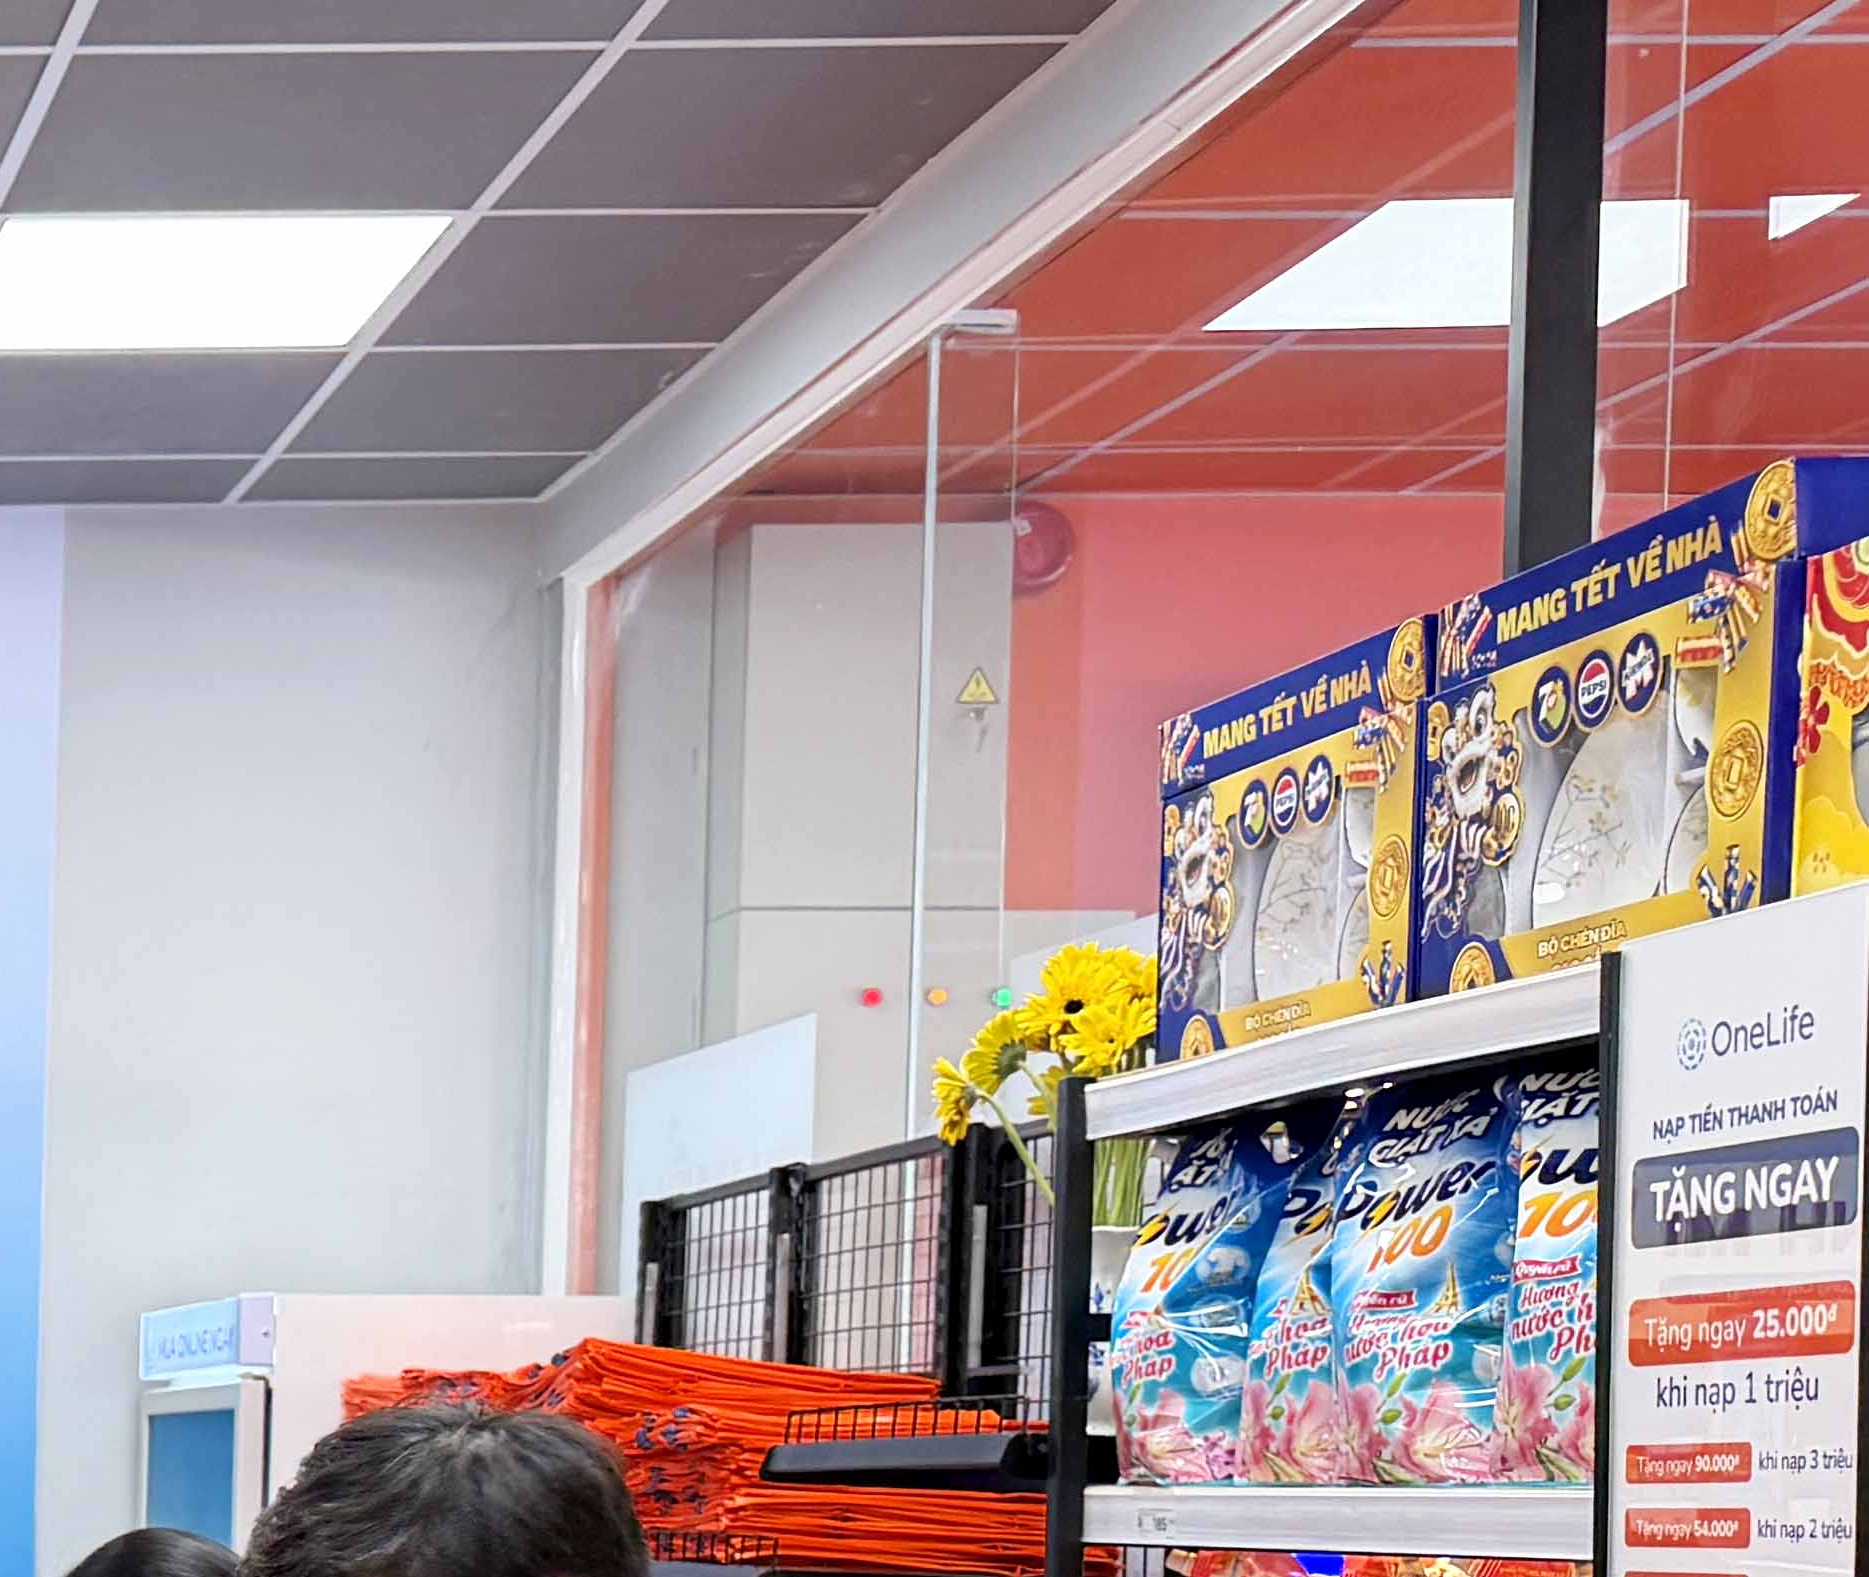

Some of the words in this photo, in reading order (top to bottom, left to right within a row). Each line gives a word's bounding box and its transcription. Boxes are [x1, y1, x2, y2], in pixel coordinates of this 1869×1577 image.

[1495, 593, 1567, 645] MANG
[1571, 564, 1620, 611] TẾT
[1625, 538, 1664, 590] VỀ
[1666, 515, 1723, 574] NHÀ
[1202, 715, 1257, 760] MANG
[1257, 692, 1298, 740] TẾT
[1300, 672, 1328, 721] VỀ
[1329, 659, 1373, 712] NHÀ
[1711, 1004, 1815, 1057] OneLife
[1653, 1118, 1685, 1146] NẠP
[1689, 1103, 1723, 1134] TIỀN
[1727, 1100, 1786, 1130] THANH
[1790, 1086, 1839, 1119] TOÁN
[1650, 1165, 1736, 1236] TẶNG
[1744, 1156, 1840, 1211] NGAY
[1375, 1339, 1451, 1379] Pháp
[1644, 1314, 1692, 1352] Tặng
[1698, 1317, 1747, 1348] ngay
[1656, 1375, 1689, 1408] khi
[1695, 1378, 1736, 1418] nạp
[1744, 1371, 1757, 1404] 1
[1764, 1366, 1819, 1411] triệu
[1758, 1452, 1779, 1470] khi
[1781, 1455, 1807, 1475] nạp
[1810, 1450, 1819, 1469] 3
[1822, 1447, 1854, 1470] triệu
[1757, 1519, 1777, 1537] khi
[1779, 1523, 1806, 1543] nạp
[1809, 1520, 1818, 1538] 2
[1821, 1518, 1852, 1541] triệu
